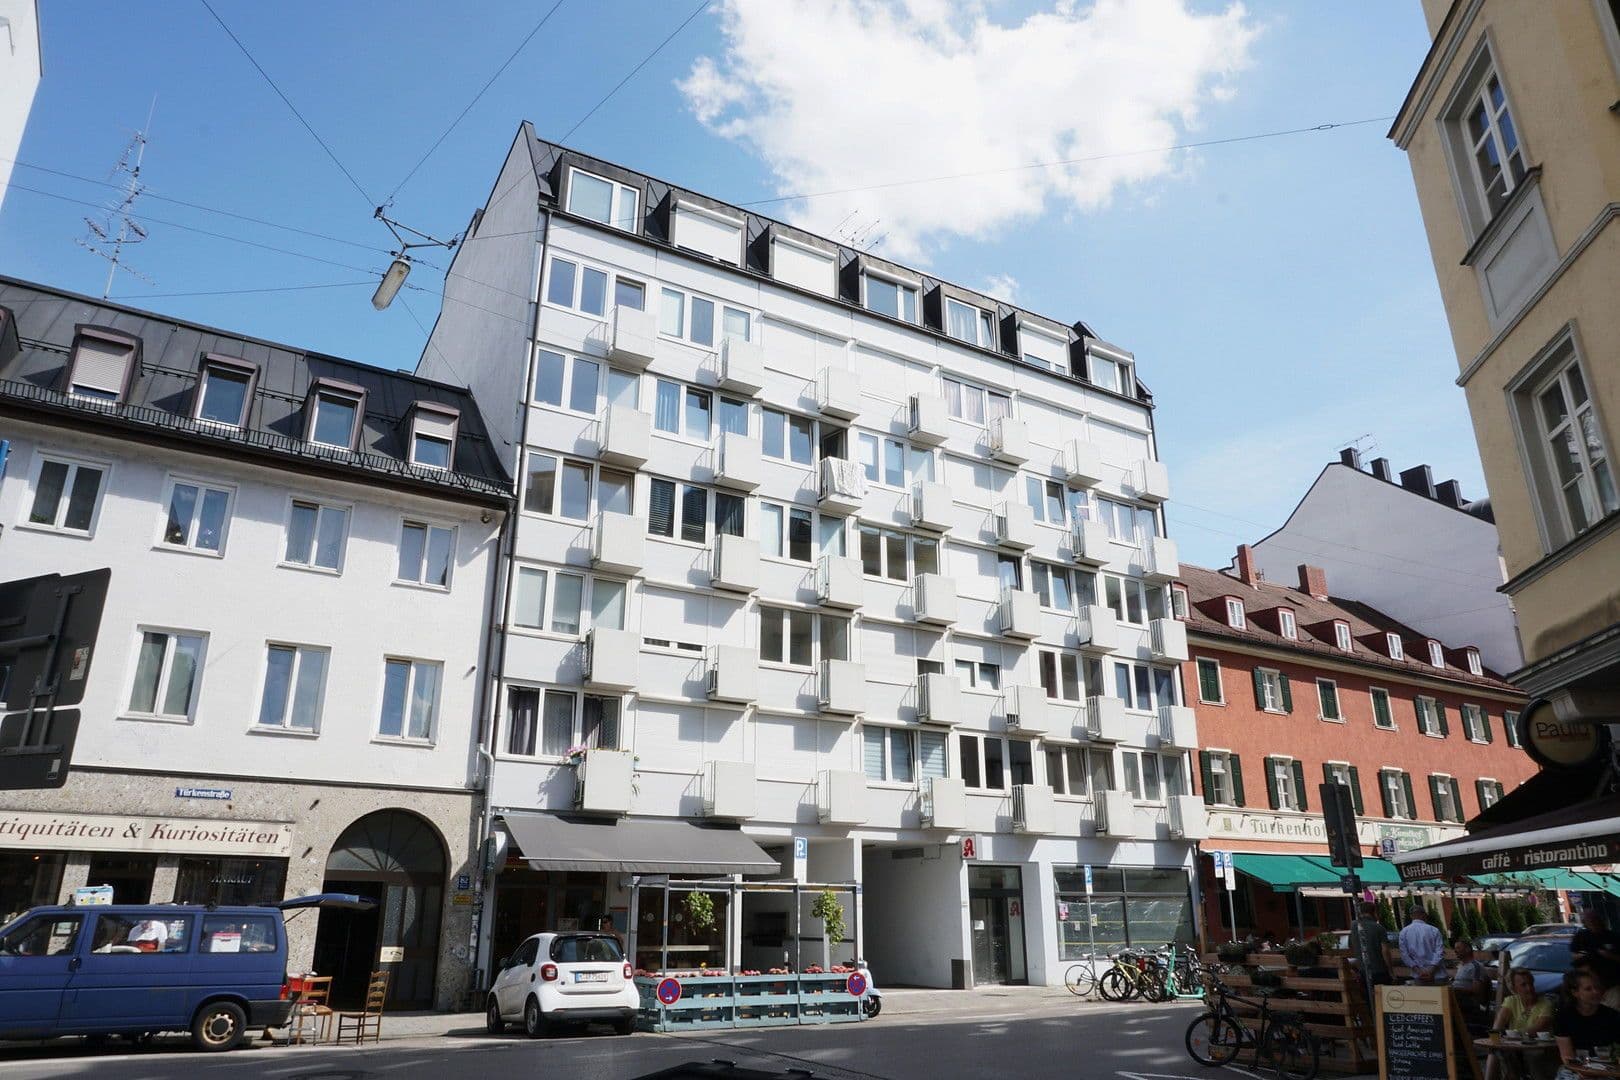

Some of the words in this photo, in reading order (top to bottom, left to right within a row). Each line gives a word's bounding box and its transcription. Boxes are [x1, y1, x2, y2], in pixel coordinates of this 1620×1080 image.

[179, 789, 230, 800] Türkenstraße
[122, 822, 143, 839] &
[149, 823, 280, 845] Kuriositäten
[1482, 851, 1511, 870] caffè
[1523, 841, 1608, 866] ristorantino
